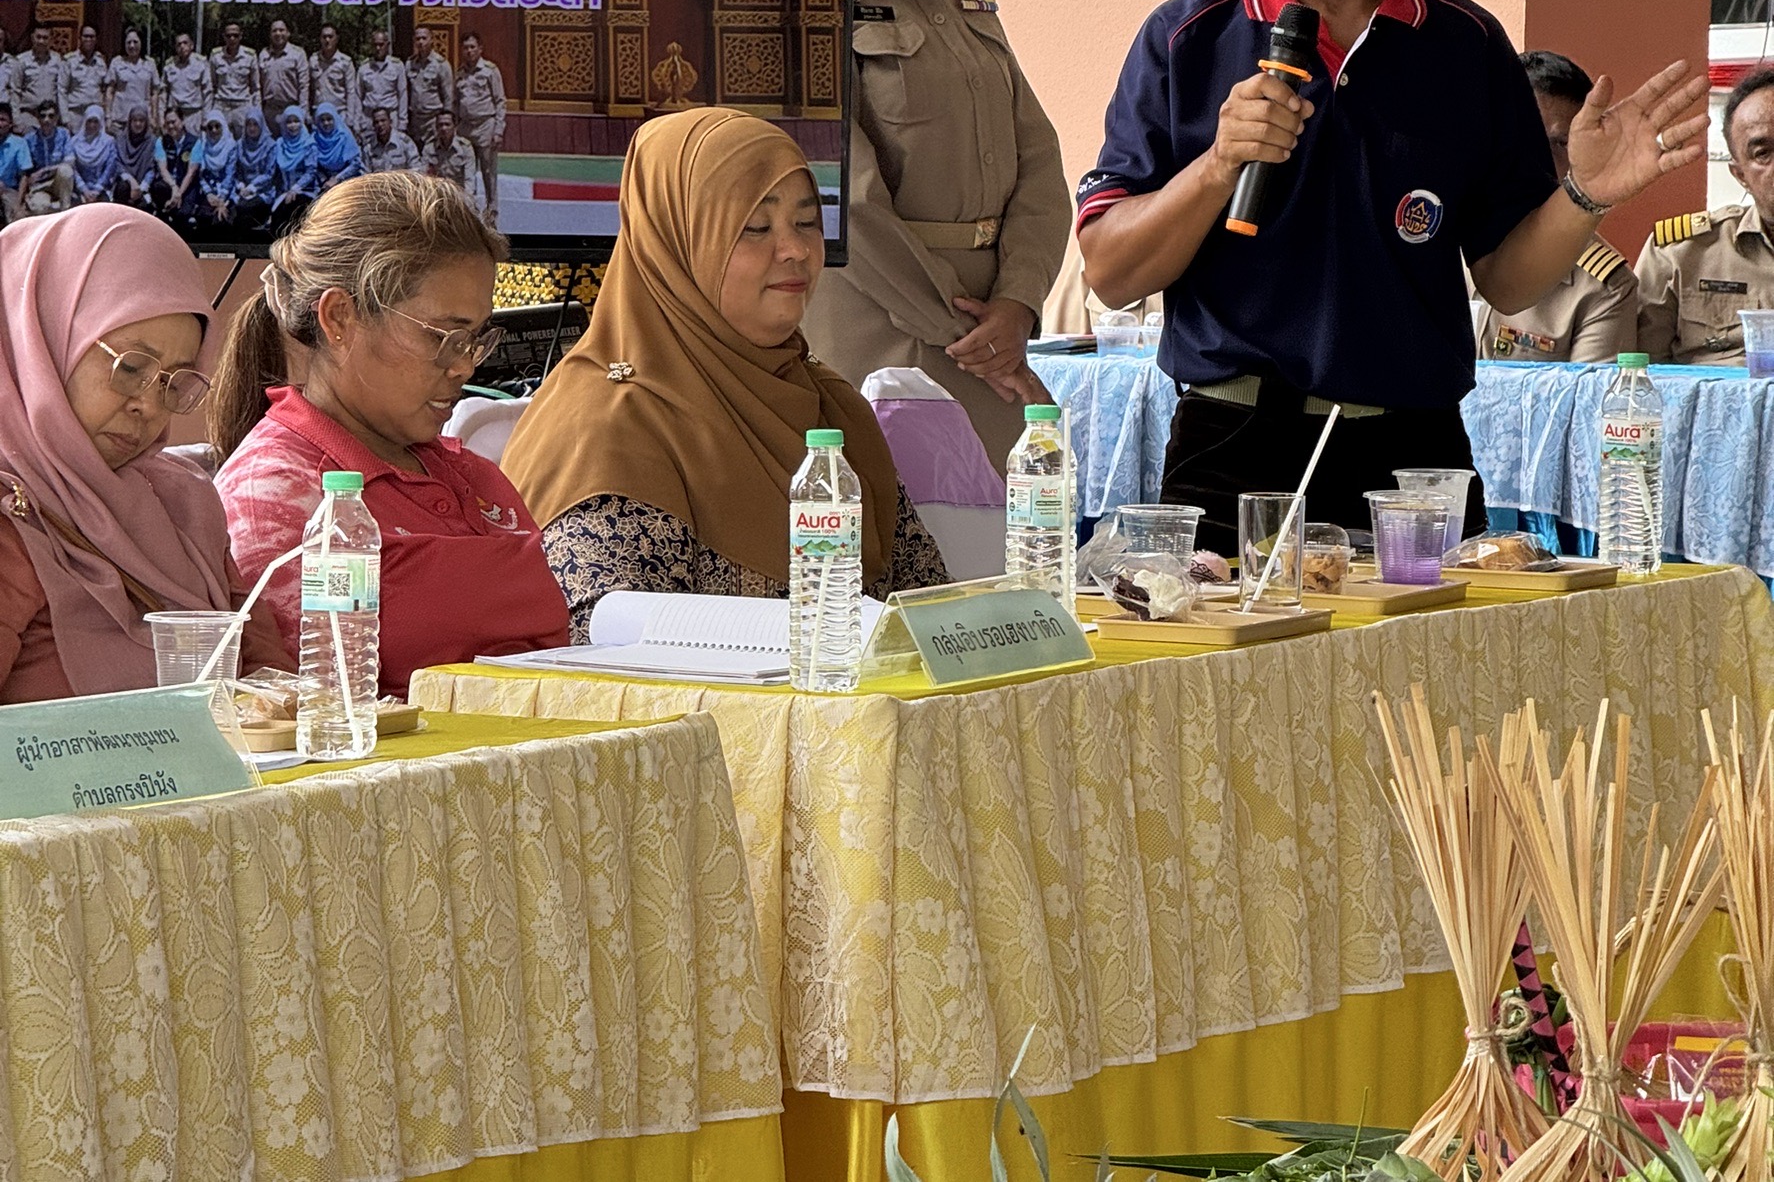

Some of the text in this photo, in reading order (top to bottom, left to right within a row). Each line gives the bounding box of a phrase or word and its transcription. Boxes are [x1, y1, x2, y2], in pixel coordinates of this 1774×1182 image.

[522, 328, 556, 341] POWERED
[1604, 423, 1641, 438] Aura
[795, 512, 841, 528] Aura
[16, 726, 181, 772] ผู้นำอาสาพัฒนาชุมชน
[72, 770, 178, 809] ตำบลกรงปินัง
